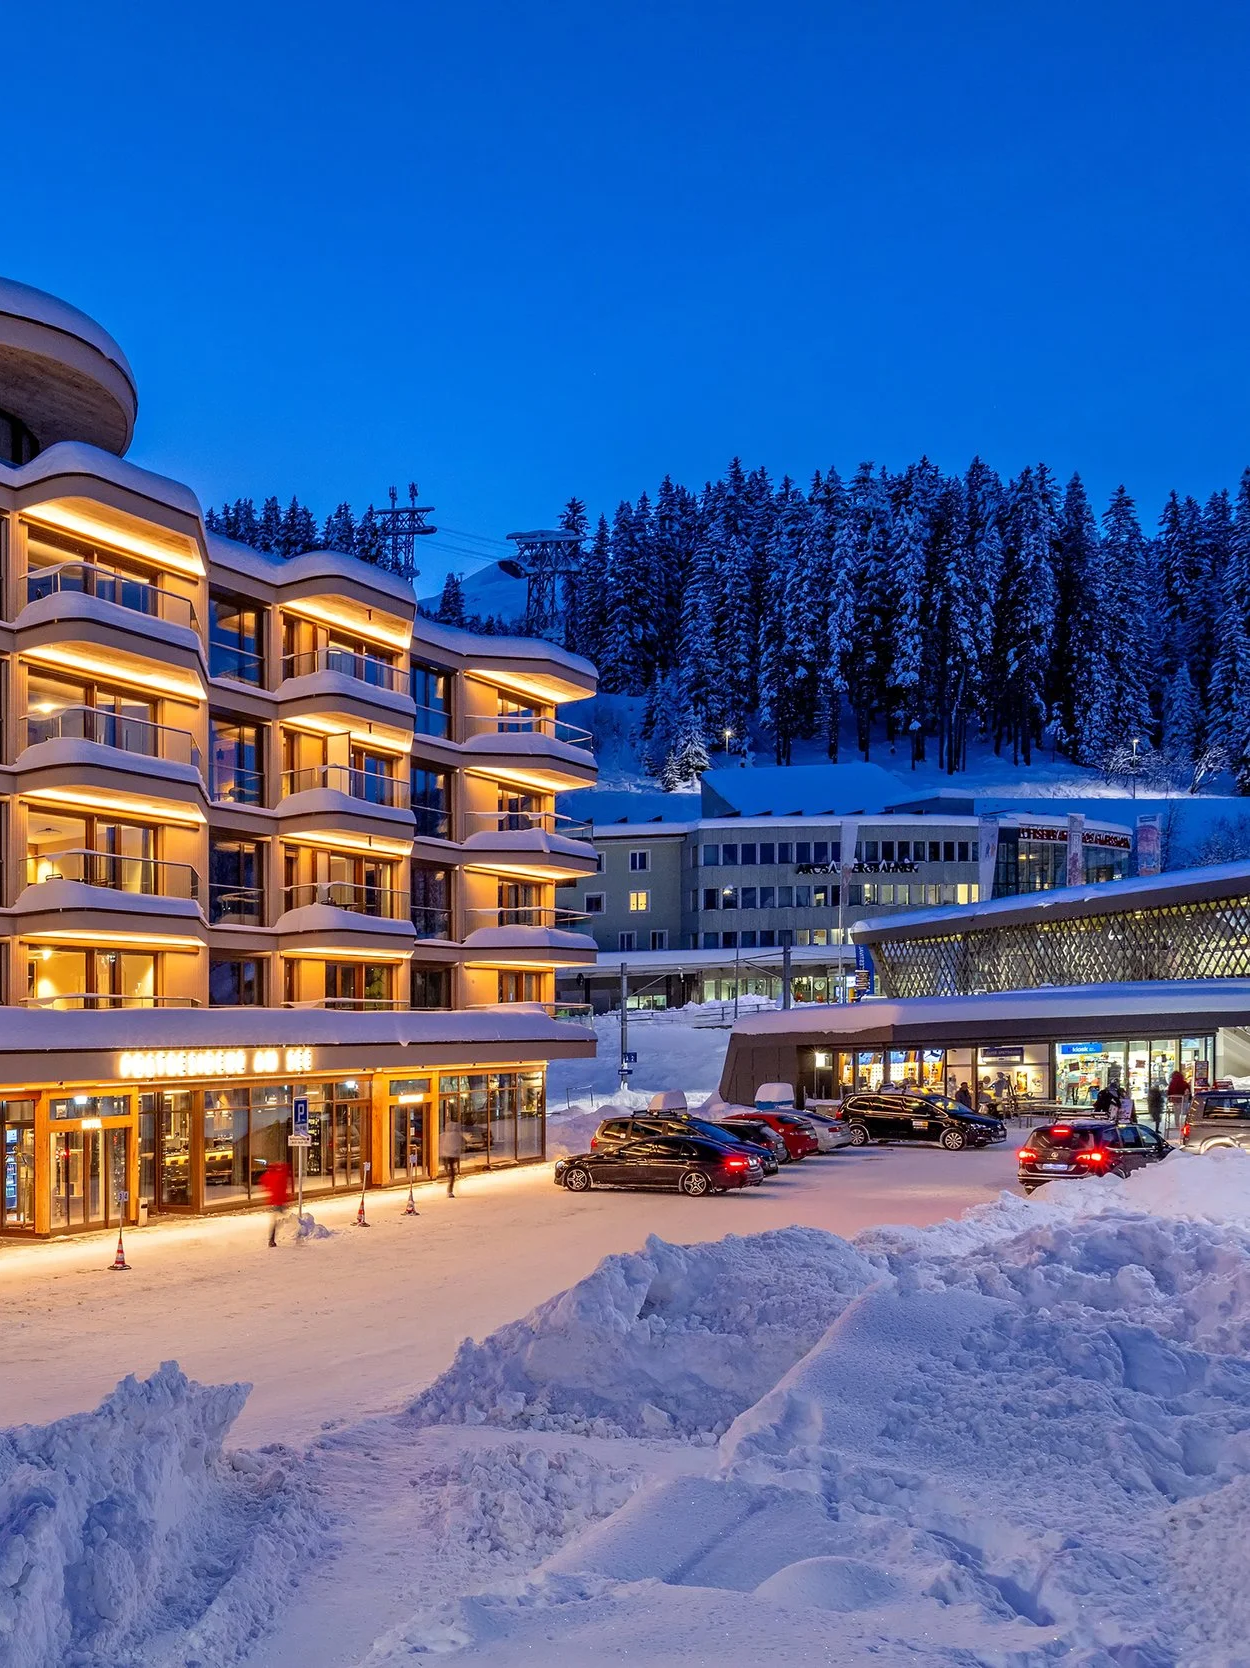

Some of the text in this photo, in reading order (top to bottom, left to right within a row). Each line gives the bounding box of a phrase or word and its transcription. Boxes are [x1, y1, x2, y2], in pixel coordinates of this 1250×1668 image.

[851, 862, 919, 873] ERGBAHNEN
[1072, 1045, 1089, 1053] kiosk
[298, 1103, 305, 1122] P
